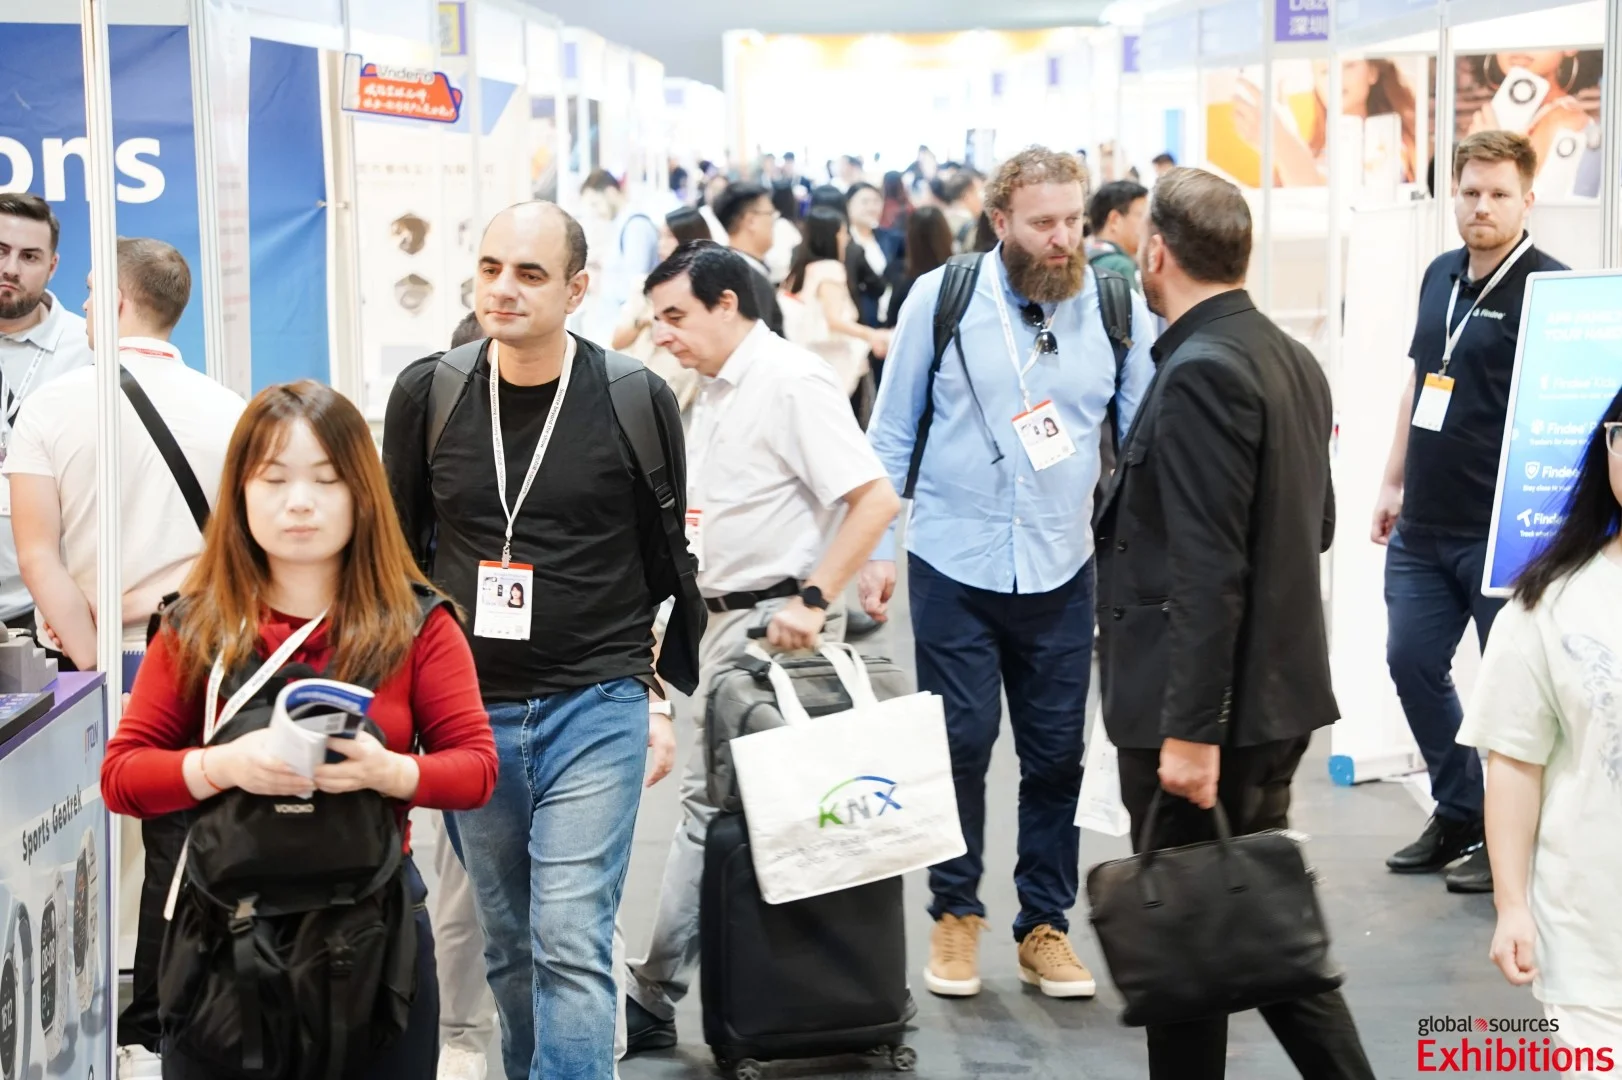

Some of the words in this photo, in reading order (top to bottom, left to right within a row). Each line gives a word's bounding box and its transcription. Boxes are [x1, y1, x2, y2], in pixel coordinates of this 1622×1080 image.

[23, 816, 50, 865] Sports
[52, 784, 83, 834] Geotrek
[818, 786, 902, 829] KNX
